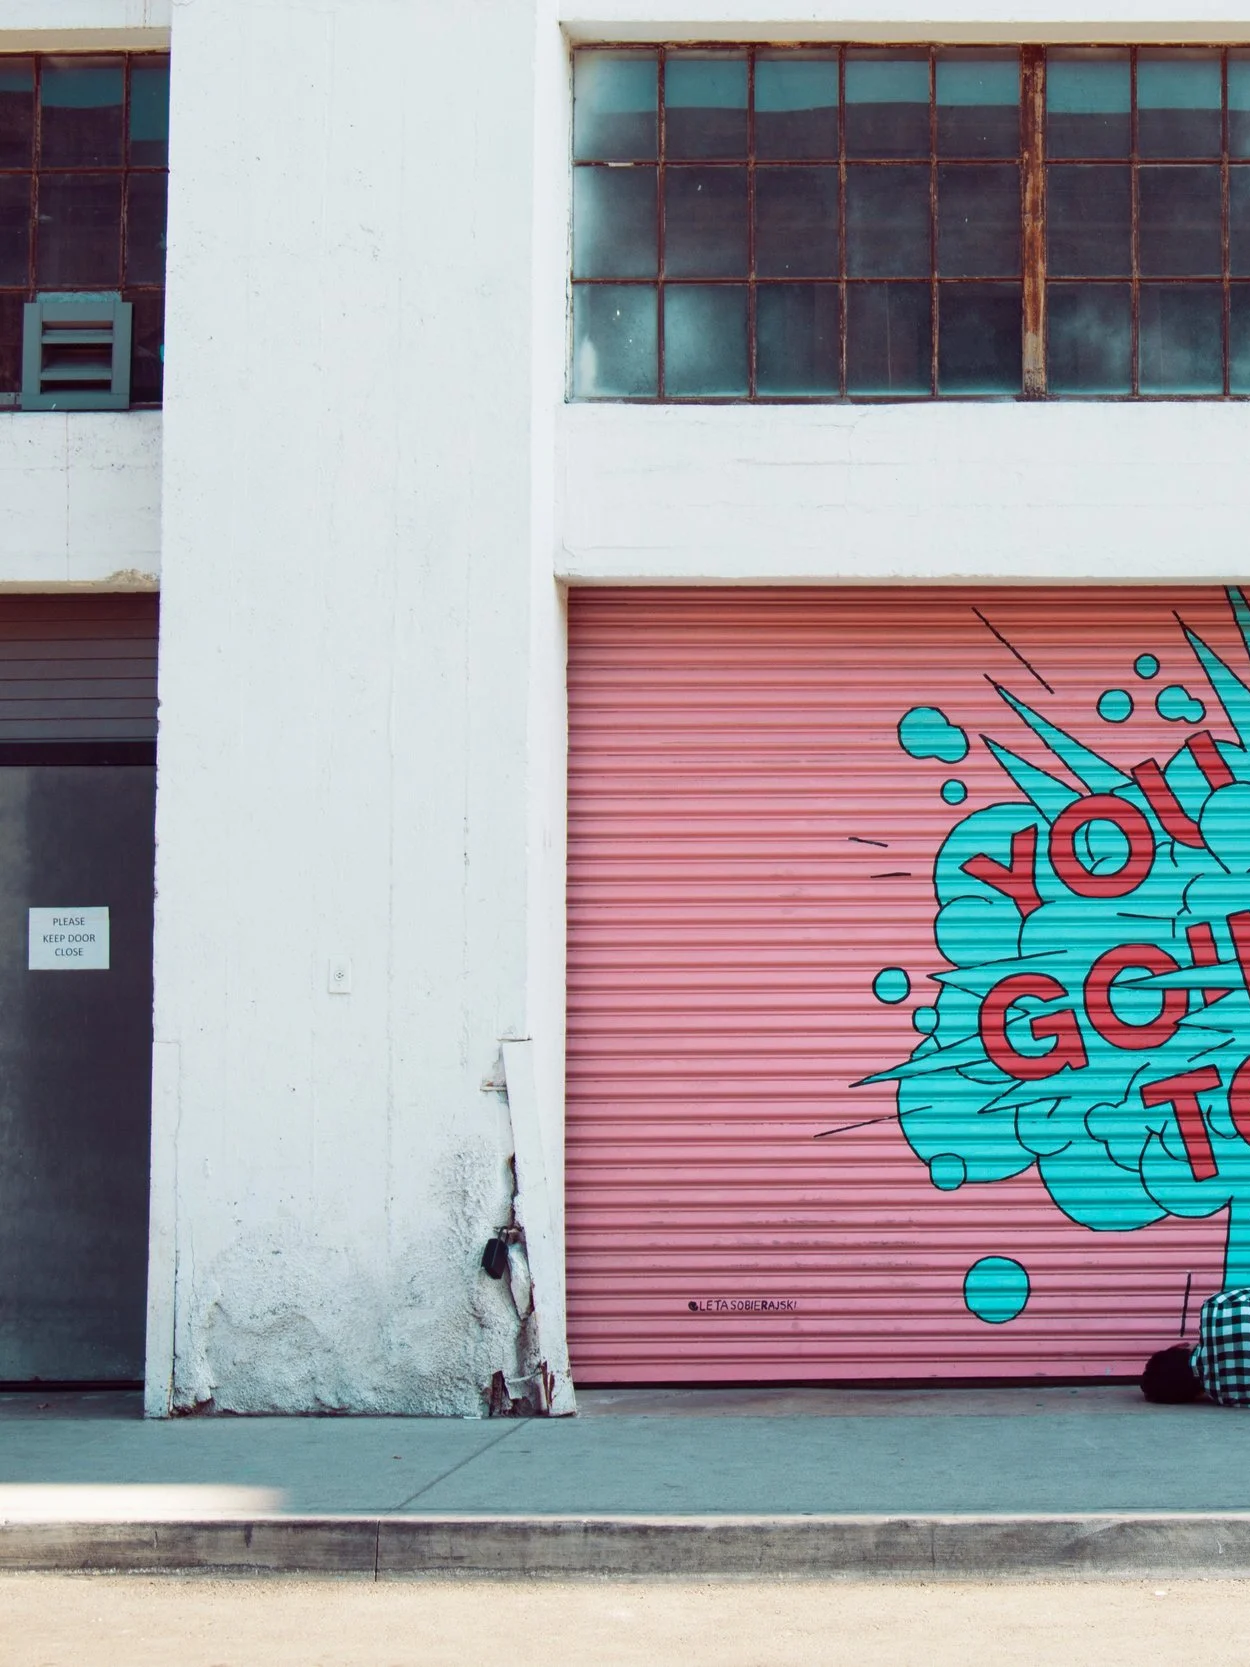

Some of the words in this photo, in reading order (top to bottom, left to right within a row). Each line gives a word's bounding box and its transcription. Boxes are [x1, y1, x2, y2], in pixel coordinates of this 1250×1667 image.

[962, 730, 1237, 917] YOU
[53, 917, 86, 926] PLEASE
[43, 934, 66, 943] KEEP
[68, 933, 96, 943] DOOR
[54, 947, 85, 957] CLOSE
